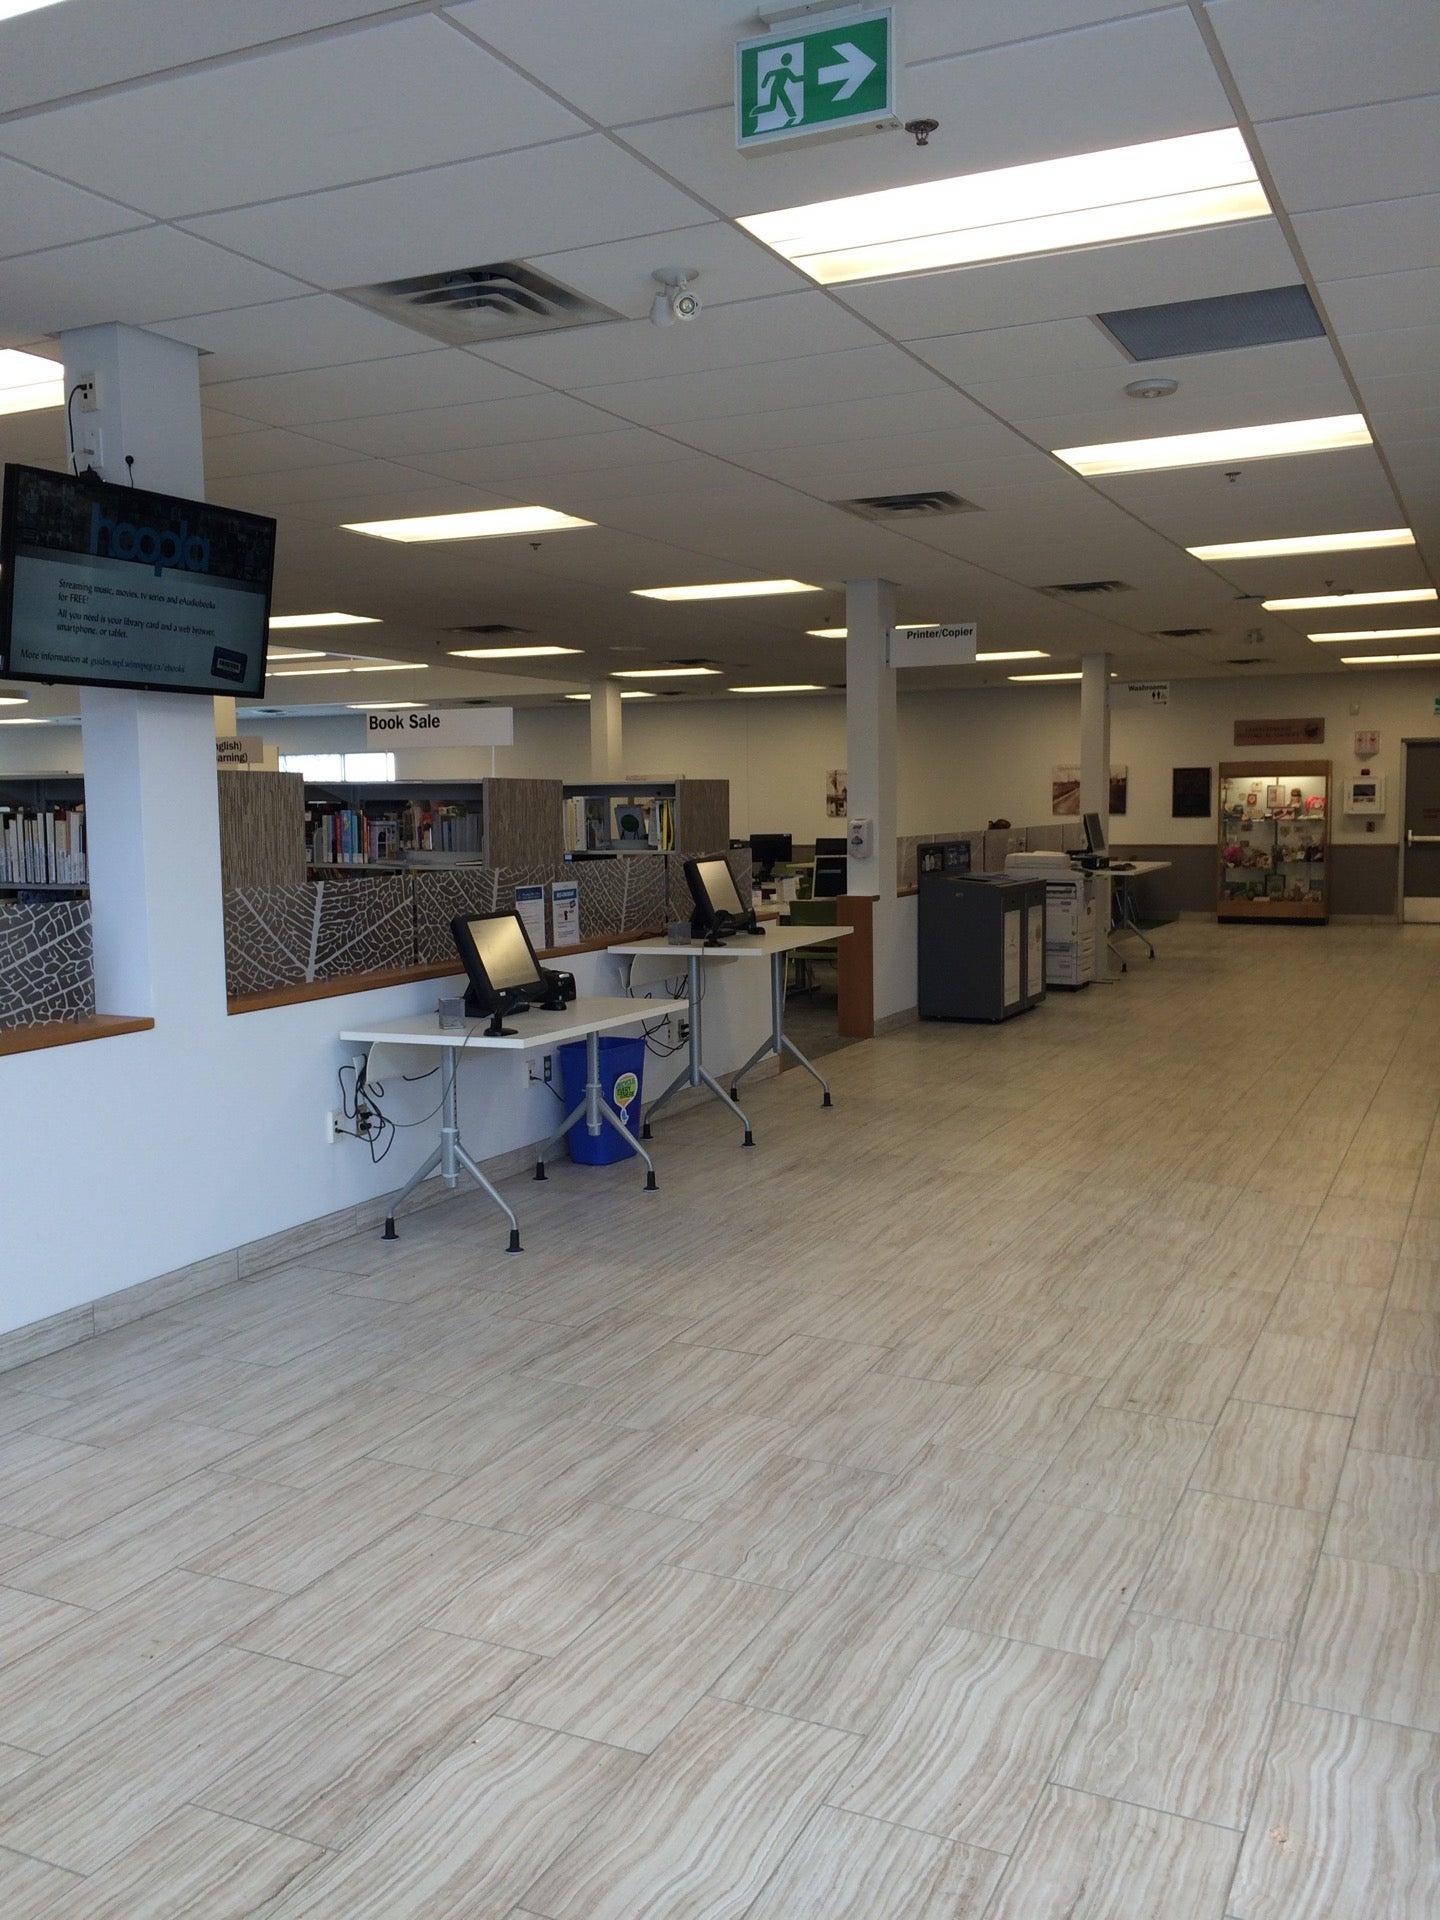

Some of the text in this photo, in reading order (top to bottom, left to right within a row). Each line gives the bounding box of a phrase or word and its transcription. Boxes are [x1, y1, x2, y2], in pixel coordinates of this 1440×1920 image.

[90, 502, 209, 577] hoopla
[58, 579, 93, 593] Streaming
[166, 594, 178, 604] and
[58, 592, 68, 602] for
[57, 608, 67, 618] All
[68, 612, 82, 622] you
[83, 613, 99, 623] need
[107, 616, 123, 627] your
[123, 617, 145, 628] library
[146, 620, 160, 630] card
[161, 622, 172, 632] and
[906, 627, 973, 640] Printer/Copier
[20, 649, 40, 661] More
[41, 652, 80, 664] information
[81, 656, 89, 664] at
[369, 713, 440, 730] Book Sale
